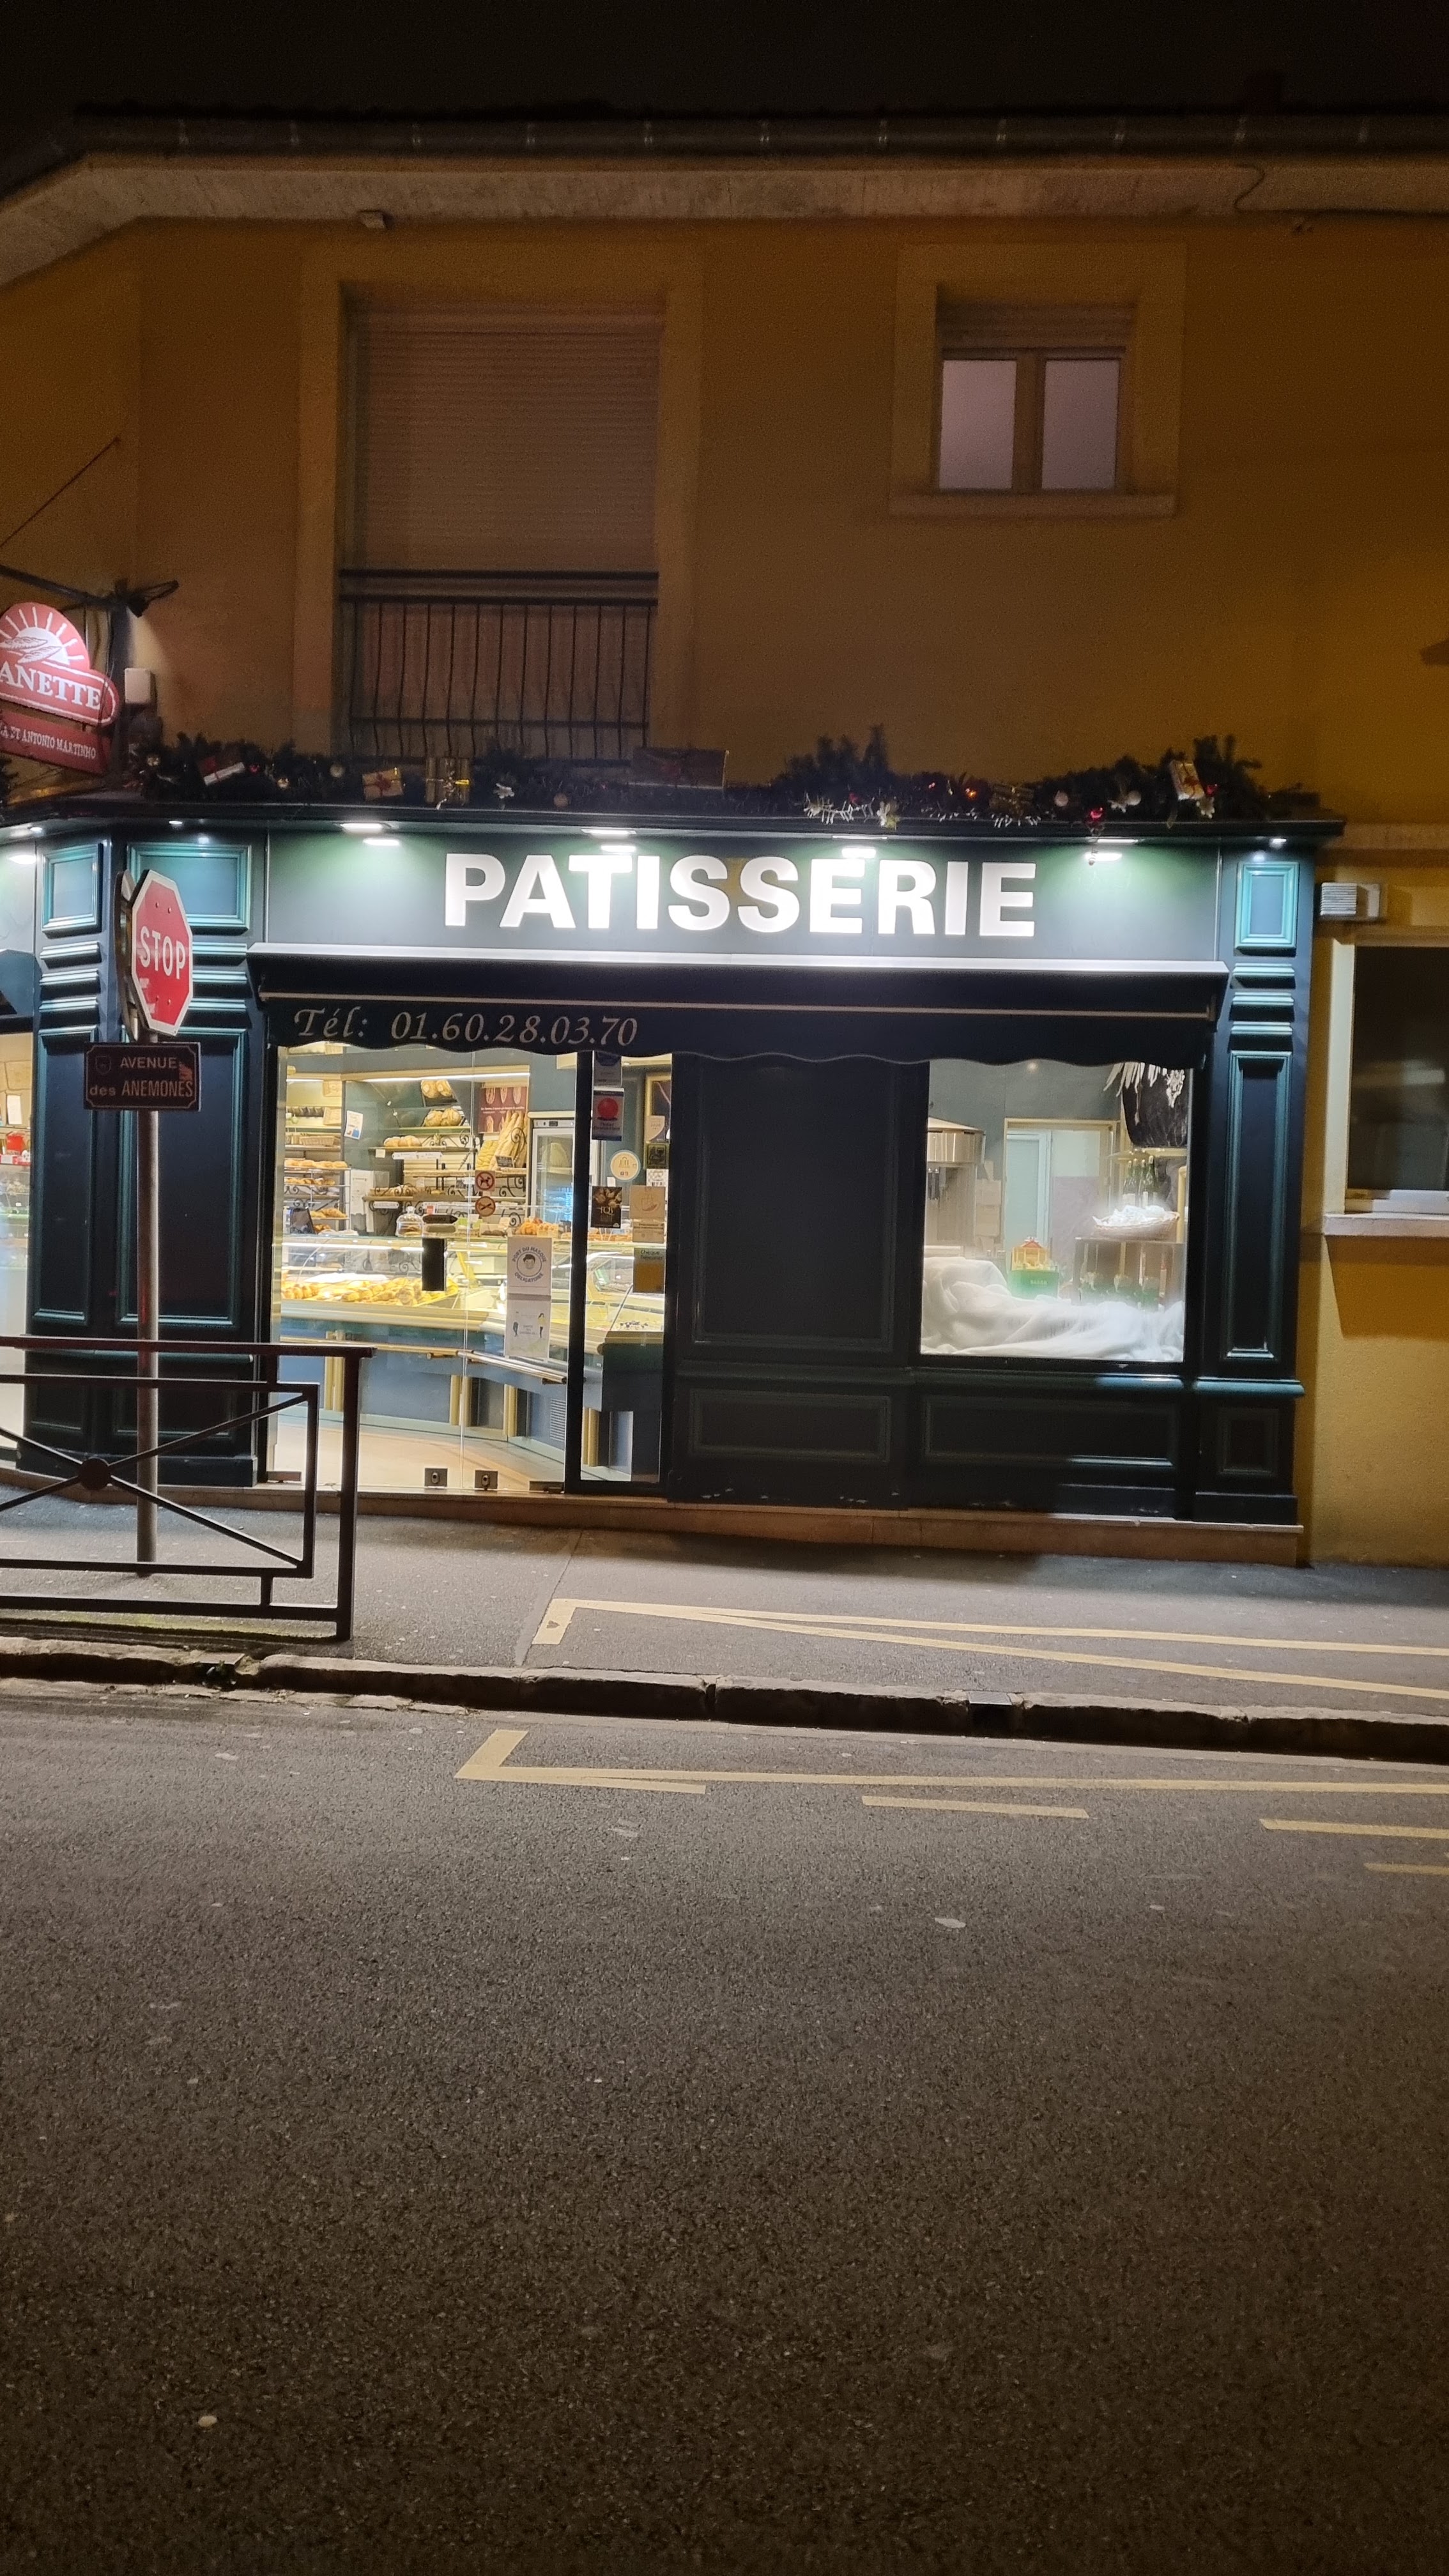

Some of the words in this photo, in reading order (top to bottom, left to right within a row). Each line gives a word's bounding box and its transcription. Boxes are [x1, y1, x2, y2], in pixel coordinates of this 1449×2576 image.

[22, 729, 56, 749] ANTONIO
[56, 738, 96, 759] MARTINHO
[445, 854, 1037, 937] PATISSERIE
[141, 925, 186, 980] STOP
[295, 1006, 368, 1038] Tél:
[391, 1011, 638, 1046] 01.60.28.03.70
[120, 1057, 178, 1069] AVENUE
[89, 1084, 116, 1096] des
[121, 1080, 193, 1098] ANEMONES
